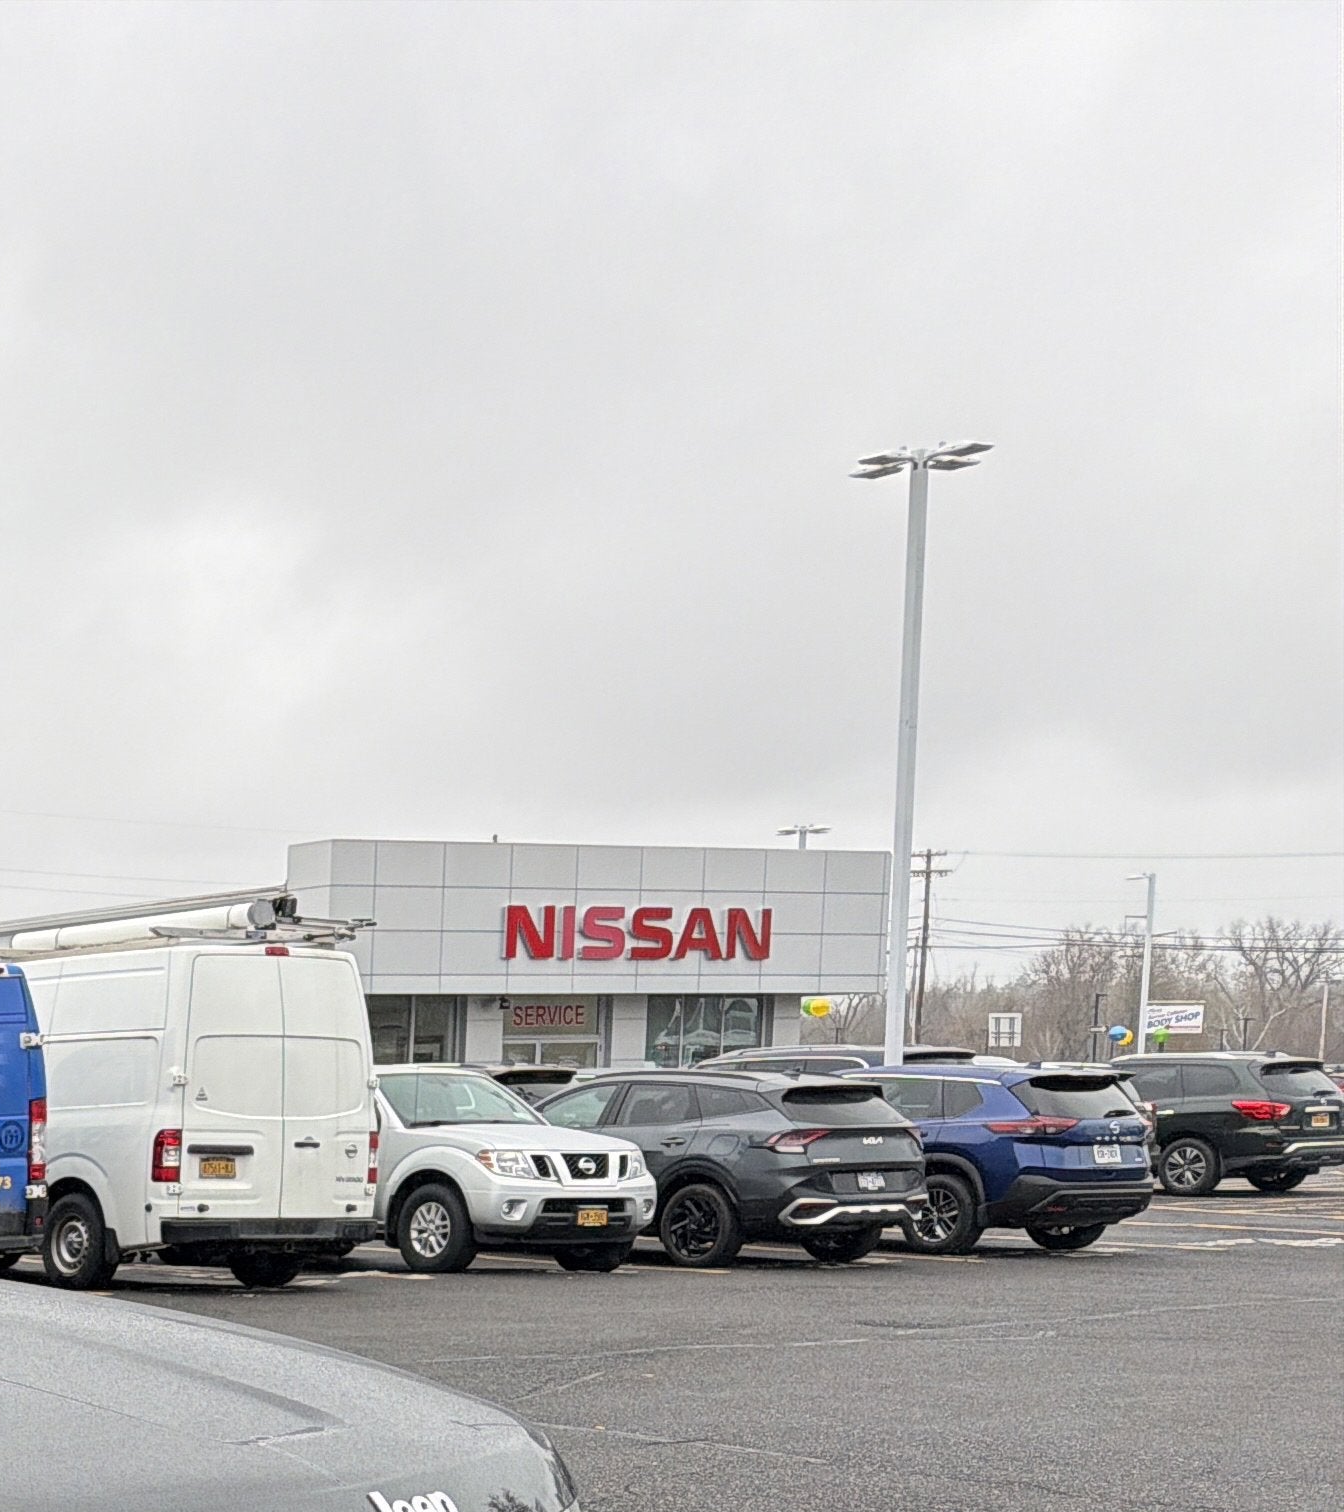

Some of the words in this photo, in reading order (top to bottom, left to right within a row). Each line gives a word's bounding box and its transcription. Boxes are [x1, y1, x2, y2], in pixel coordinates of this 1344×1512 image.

[506, 904, 772, 960] NISSAN
[513, 1005, 585, 1026] SERVICE
[1147, 1018, 1173, 1029] BODY
[1174, 1011, 1200, 1024] SHOP
